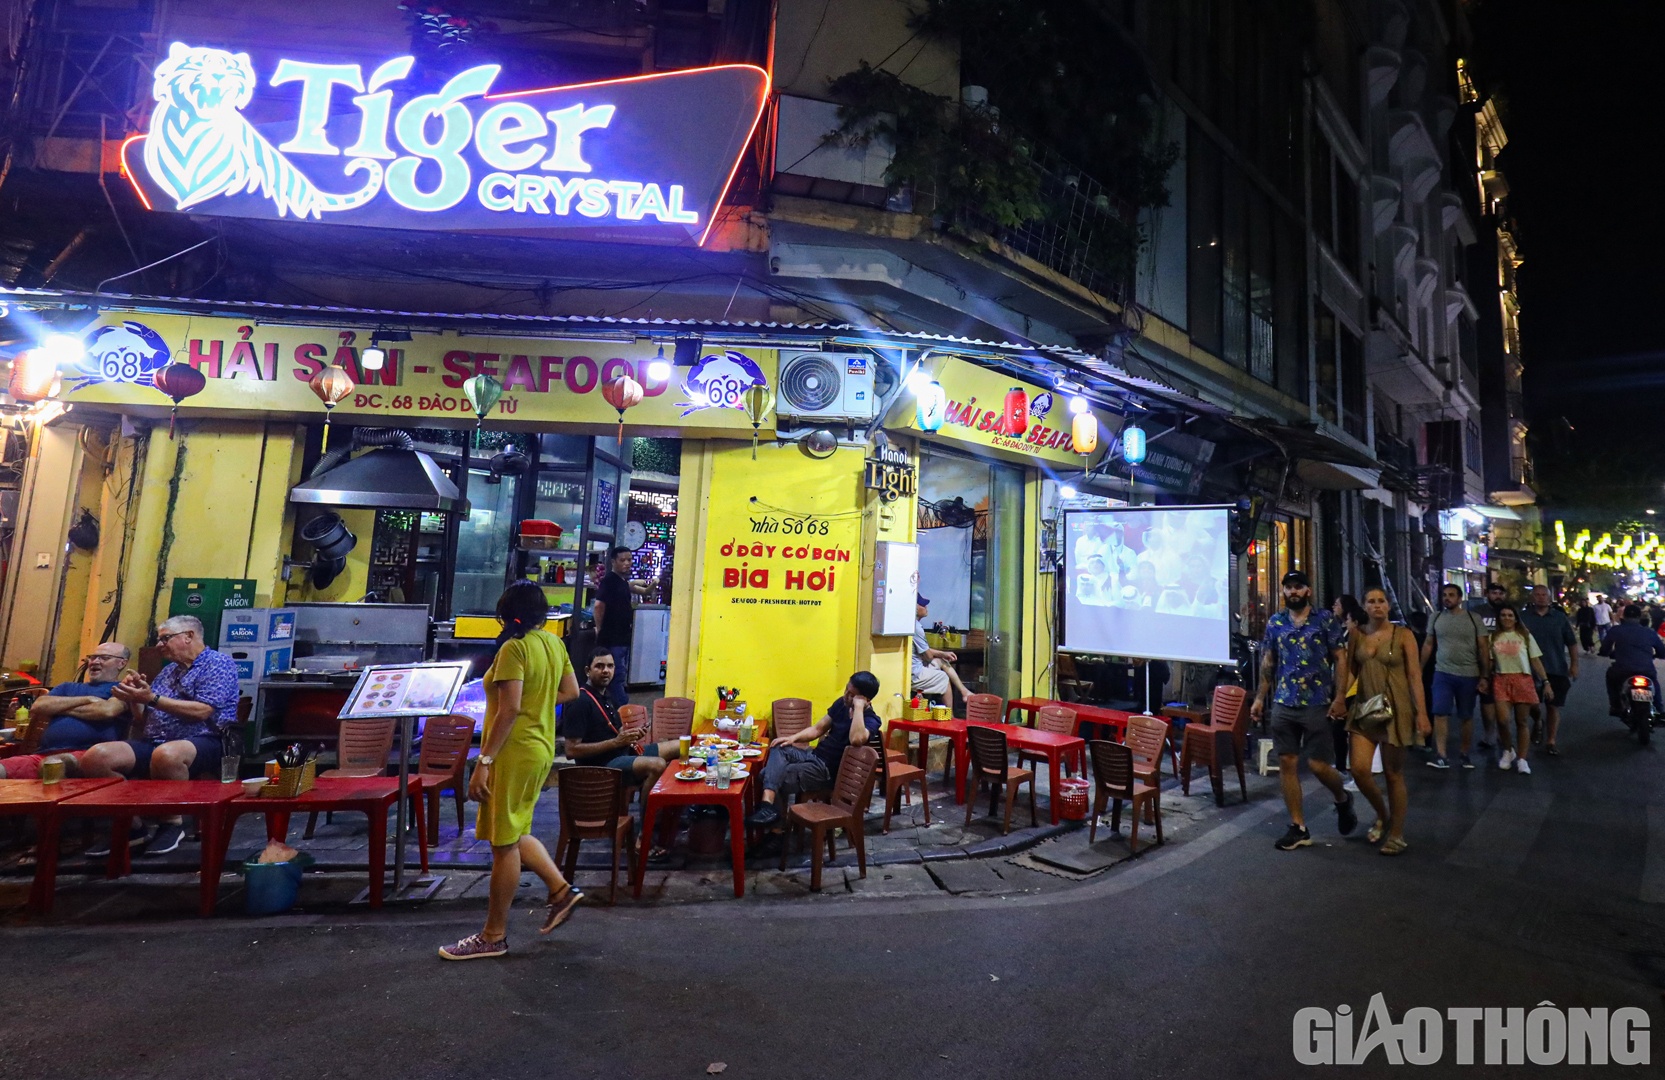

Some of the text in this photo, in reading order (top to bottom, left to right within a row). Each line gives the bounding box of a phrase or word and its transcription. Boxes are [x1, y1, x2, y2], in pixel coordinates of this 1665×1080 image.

[269, 55, 616, 212] Tiger
[478, 172, 698, 224] CRYSTAL
[103, 351, 138, 379] 68
[189, 325, 278, 381] HẢI
[418, 393, 457, 411] ĐÀO
[498, 395, 519, 414] TỪ
[708, 378, 739, 404] 68
[880, 444, 908, 464] Hanoi
[871, 463, 916, 502] Light
[807, 519, 830, 536] 68
[224, 598, 249, 607] SAIGON
